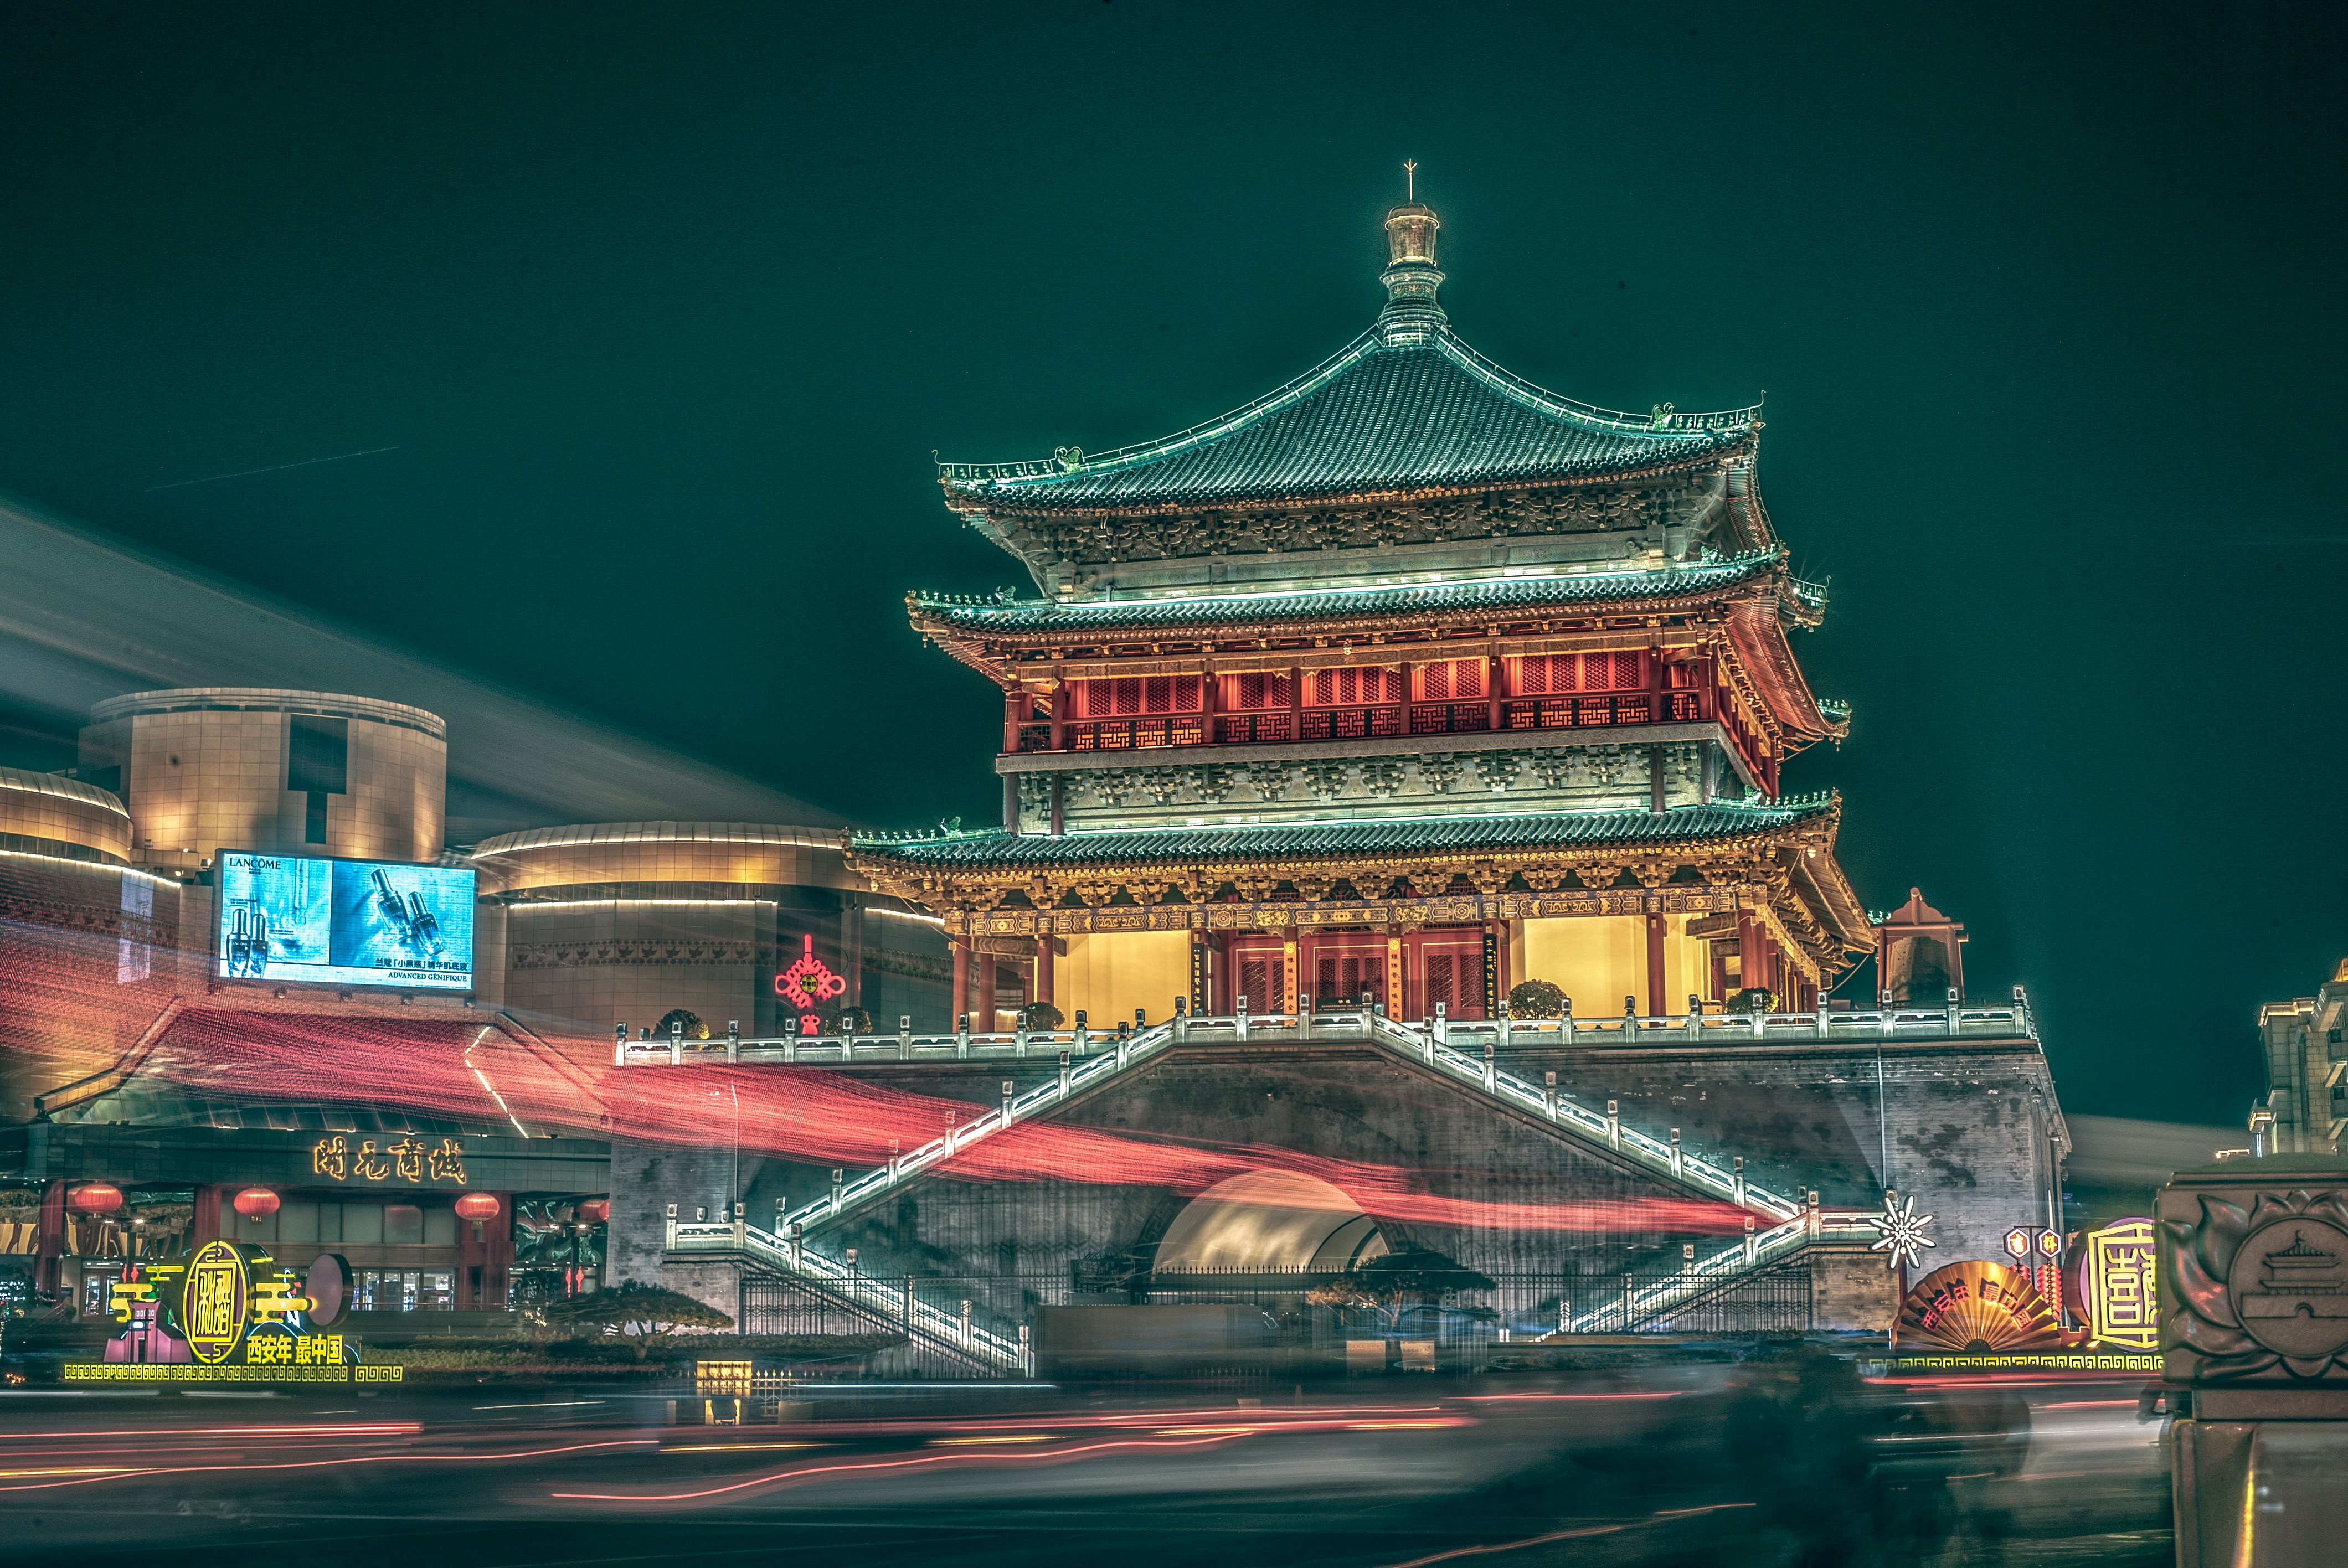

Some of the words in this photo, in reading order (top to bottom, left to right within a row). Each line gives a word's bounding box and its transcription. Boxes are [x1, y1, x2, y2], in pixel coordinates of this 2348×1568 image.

[229, 858, 281, 870] LANCÔME
[388, 972, 426, 980] ADVANCED
[428, 973, 467, 982] GÉNIFIQUE
[247, 1334, 292, 1364] 西安年
[295, 1334, 343, 1365] 最中国
